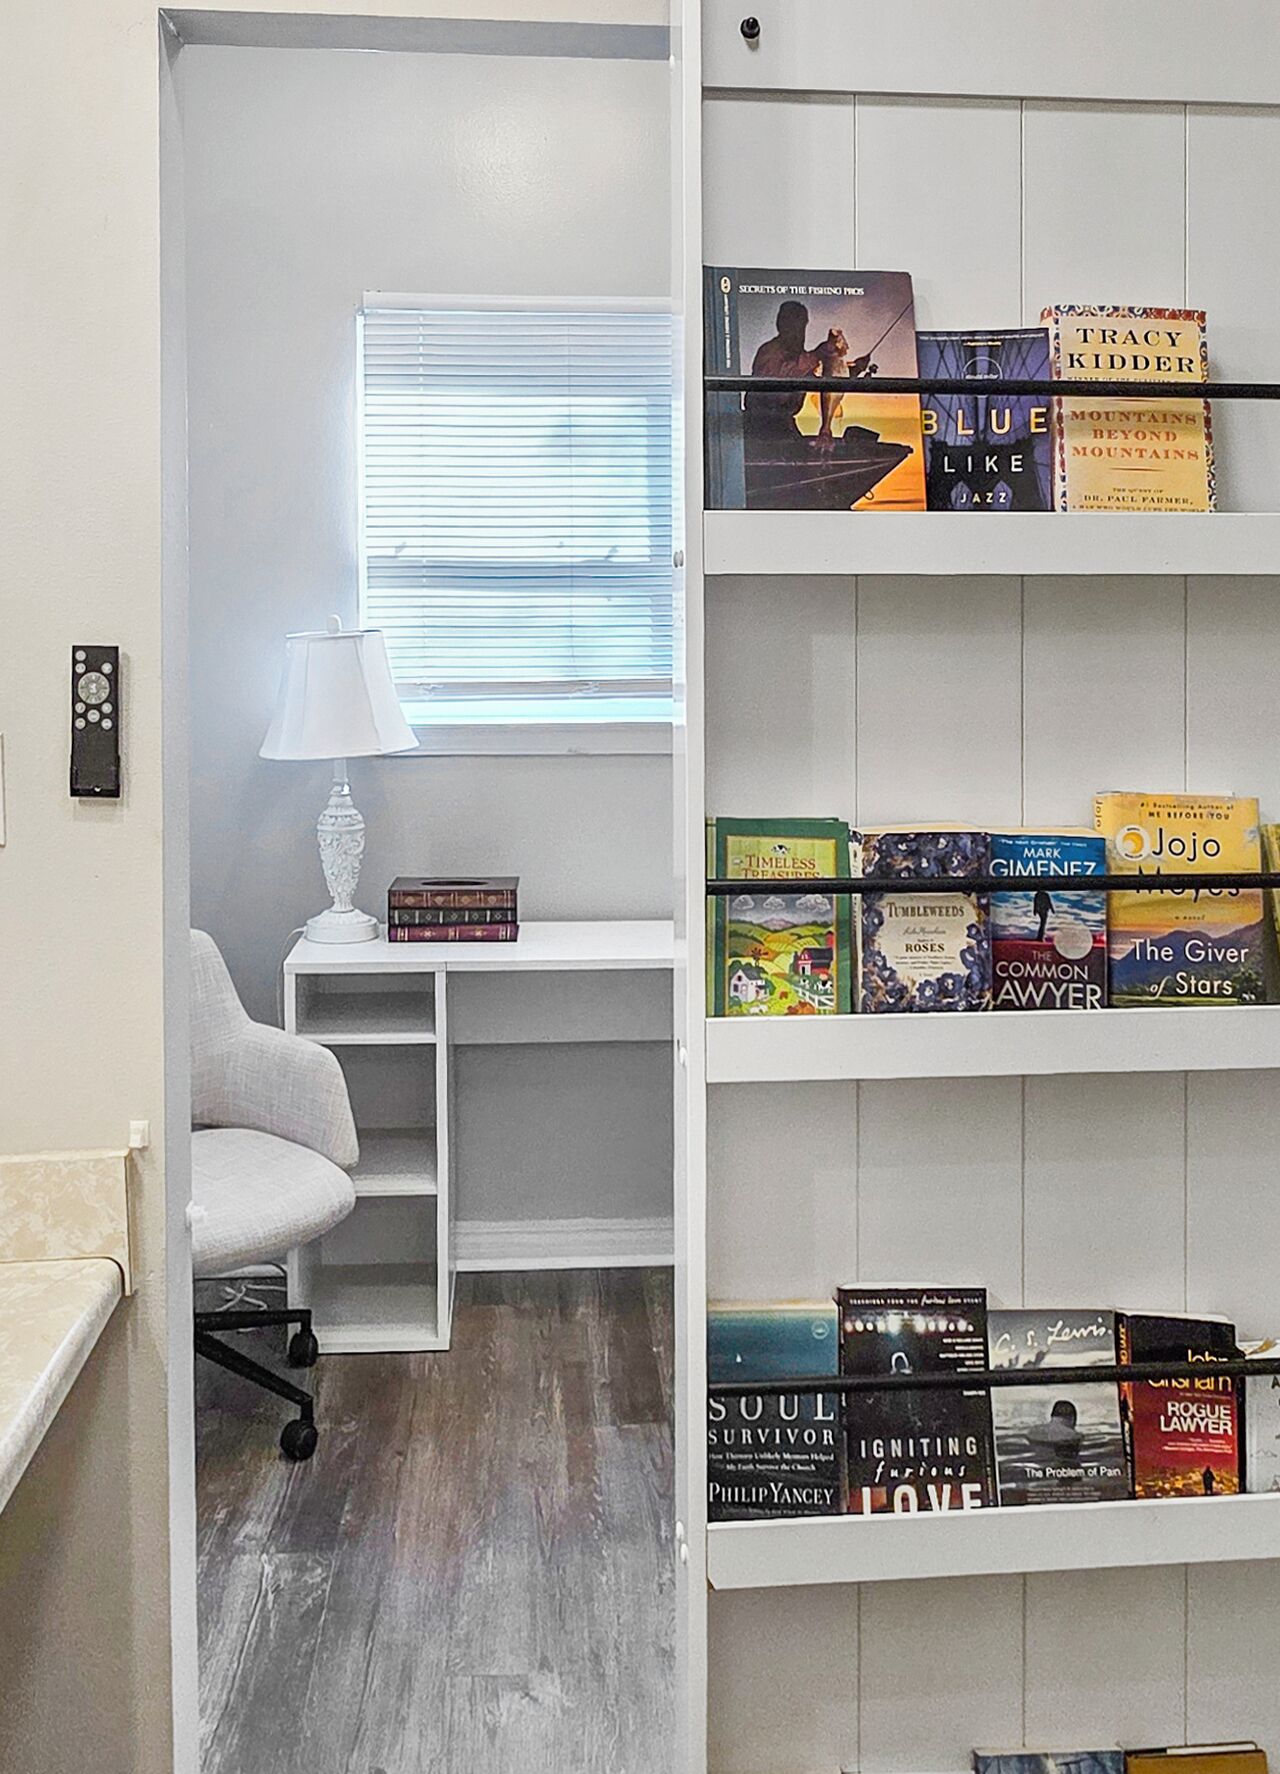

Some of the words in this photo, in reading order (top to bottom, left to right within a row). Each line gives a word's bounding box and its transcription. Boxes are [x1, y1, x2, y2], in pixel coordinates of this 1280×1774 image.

[739, 285, 775, 294] SECRETS
[776, 285, 788, 294] OF
[789, 285, 807, 295] THE
[808, 286, 842, 295] FISHING
[843, 287, 865, 296] PROS
[1076, 328, 1182, 347] TRACY
[1068, 353, 1194, 373] KIDDER
[922, 407, 1048, 435] BLUE
[1071, 410, 1197, 425] MOUNTAINS
[1093, 429, 1177, 442] BEYOND
[1072, 446, 1199, 460] MOUNTAINS
[944, 455, 1024, 473] LIKE
[960, 493, 1007, 503] JAZZ
[1142, 497, 1194, 505] FARMER,
[1209, 812, 1230, 820] YOU
[1023, 848, 1061, 859] MARK
[1152, 828, 1220, 862] Jojo
[745, 854, 816, 870] TIMELESS
[989, 859, 1097, 877] GIMENEZ
[886, 902, 965, 918] TUMBLEWEEDS
[905, 943, 945, 953] ROSES
[1032, 950, 1052, 961] THE
[1131, 938, 1174, 962] The
[1185, 939, 1249, 963] Giver
[996, 961, 1089, 980] COMMON
[996, 980, 1102, 1009] AWYER
[1150, 975, 1174, 1000] of
[1176, 972, 1233, 996] Stars
[994, 1333, 1016, 1353] C.
[1026, 1330, 1038, 1347] S.
[1271, 1375, 1280, 1389] A
[709, 1393, 834, 1421] SOUL
[1167, 1401, 1232, 1420] ROGUE
[1160, 1414, 1233, 1436] LAWYER
[709, 1428, 834, 1445] SURVIVOR
[861, 1436, 978, 1458] IGNITING
[874, 1460, 966, 1484] furious
[1025, 1467, 1043, 1478] The
[1045, 1467, 1085, 1478] Problem
[1087, 1467, 1098, 1477] of
[1100, 1466, 1121, 1477] Pain
[709, 1482, 769, 1503] PHILIP
[770, 1482, 834, 1505] YANCEY
[862, 1483, 982, 1514] LOVE
